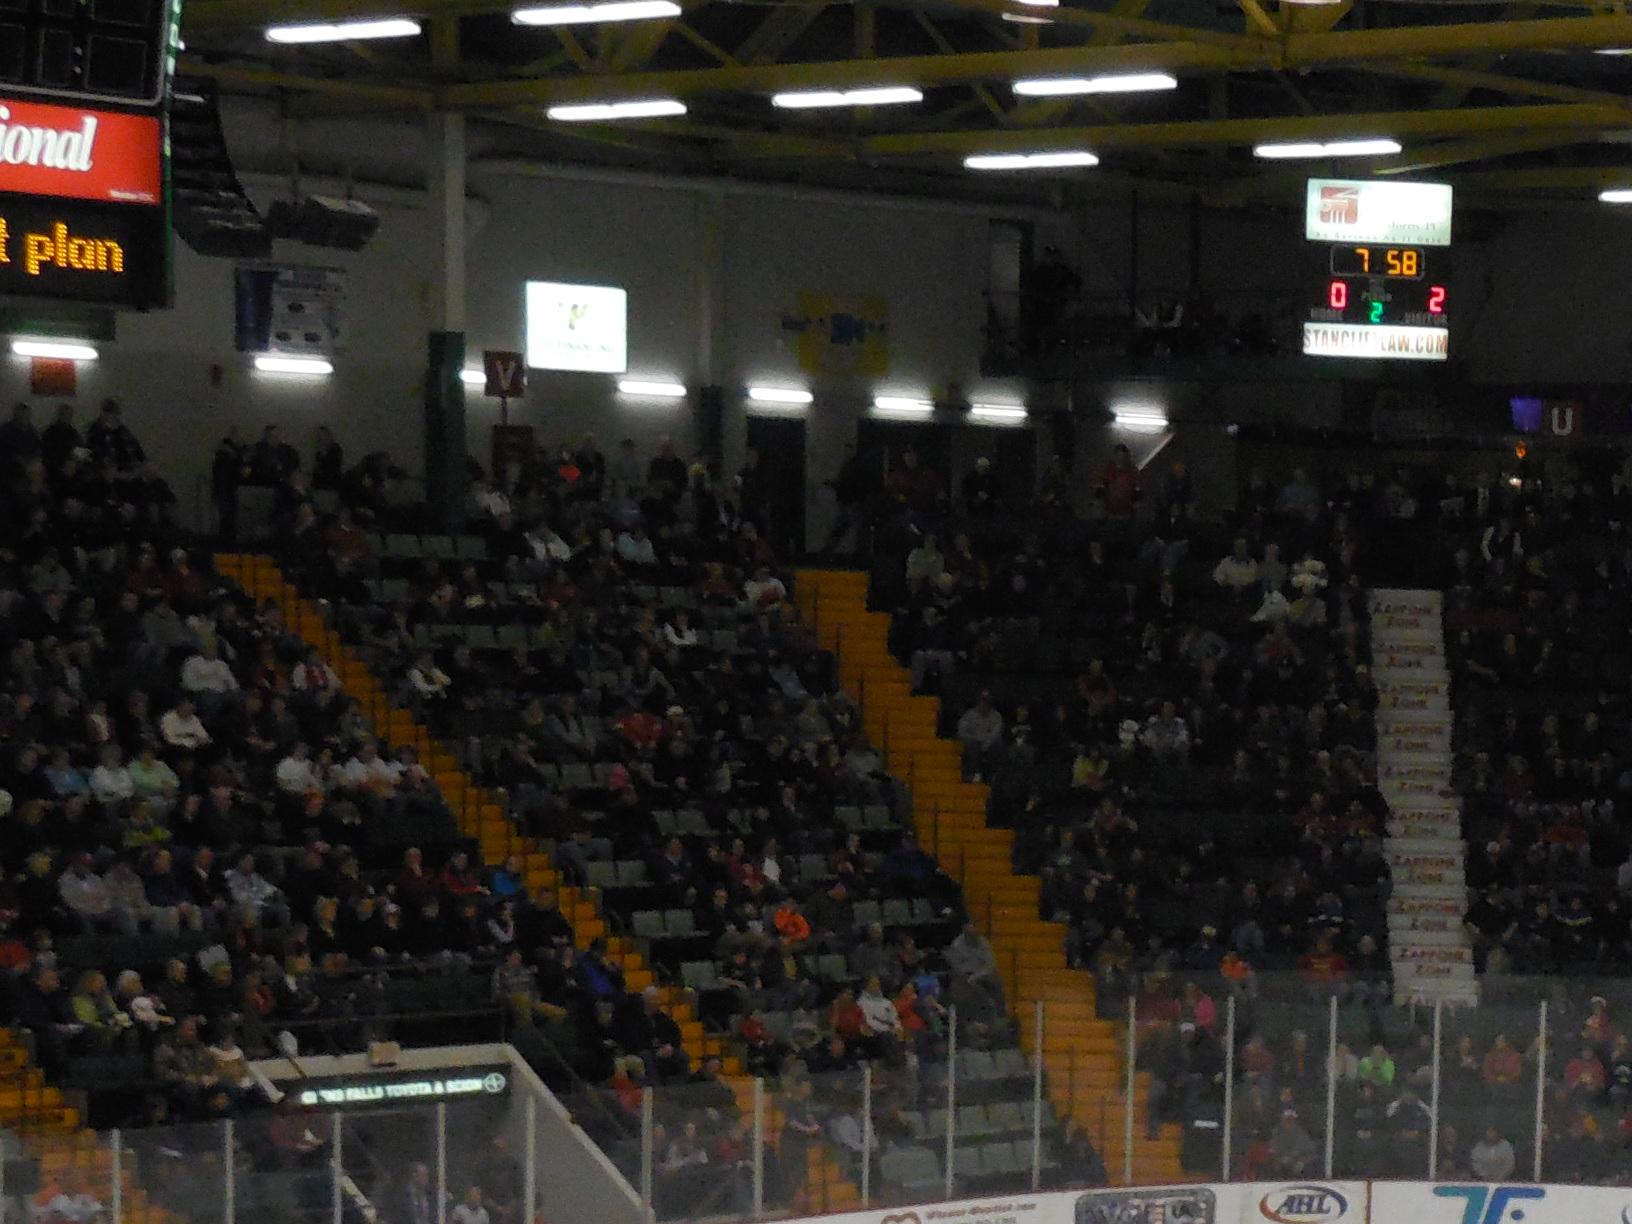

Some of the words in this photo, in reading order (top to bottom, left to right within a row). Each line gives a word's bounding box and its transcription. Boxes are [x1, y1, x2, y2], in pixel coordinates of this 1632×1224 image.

[25, 221, 124, 275] plan
[1355, 248, 1369, 272] 7
[1387, 250, 1417, 275] 58
[1331, 282, 1346, 308] 0
[1429, 287, 1445, 313] 2
[1370, 302, 1383, 322] 2
[1551, 407, 1573, 436] U
[1276, 1194, 1331, 1214] AHL
